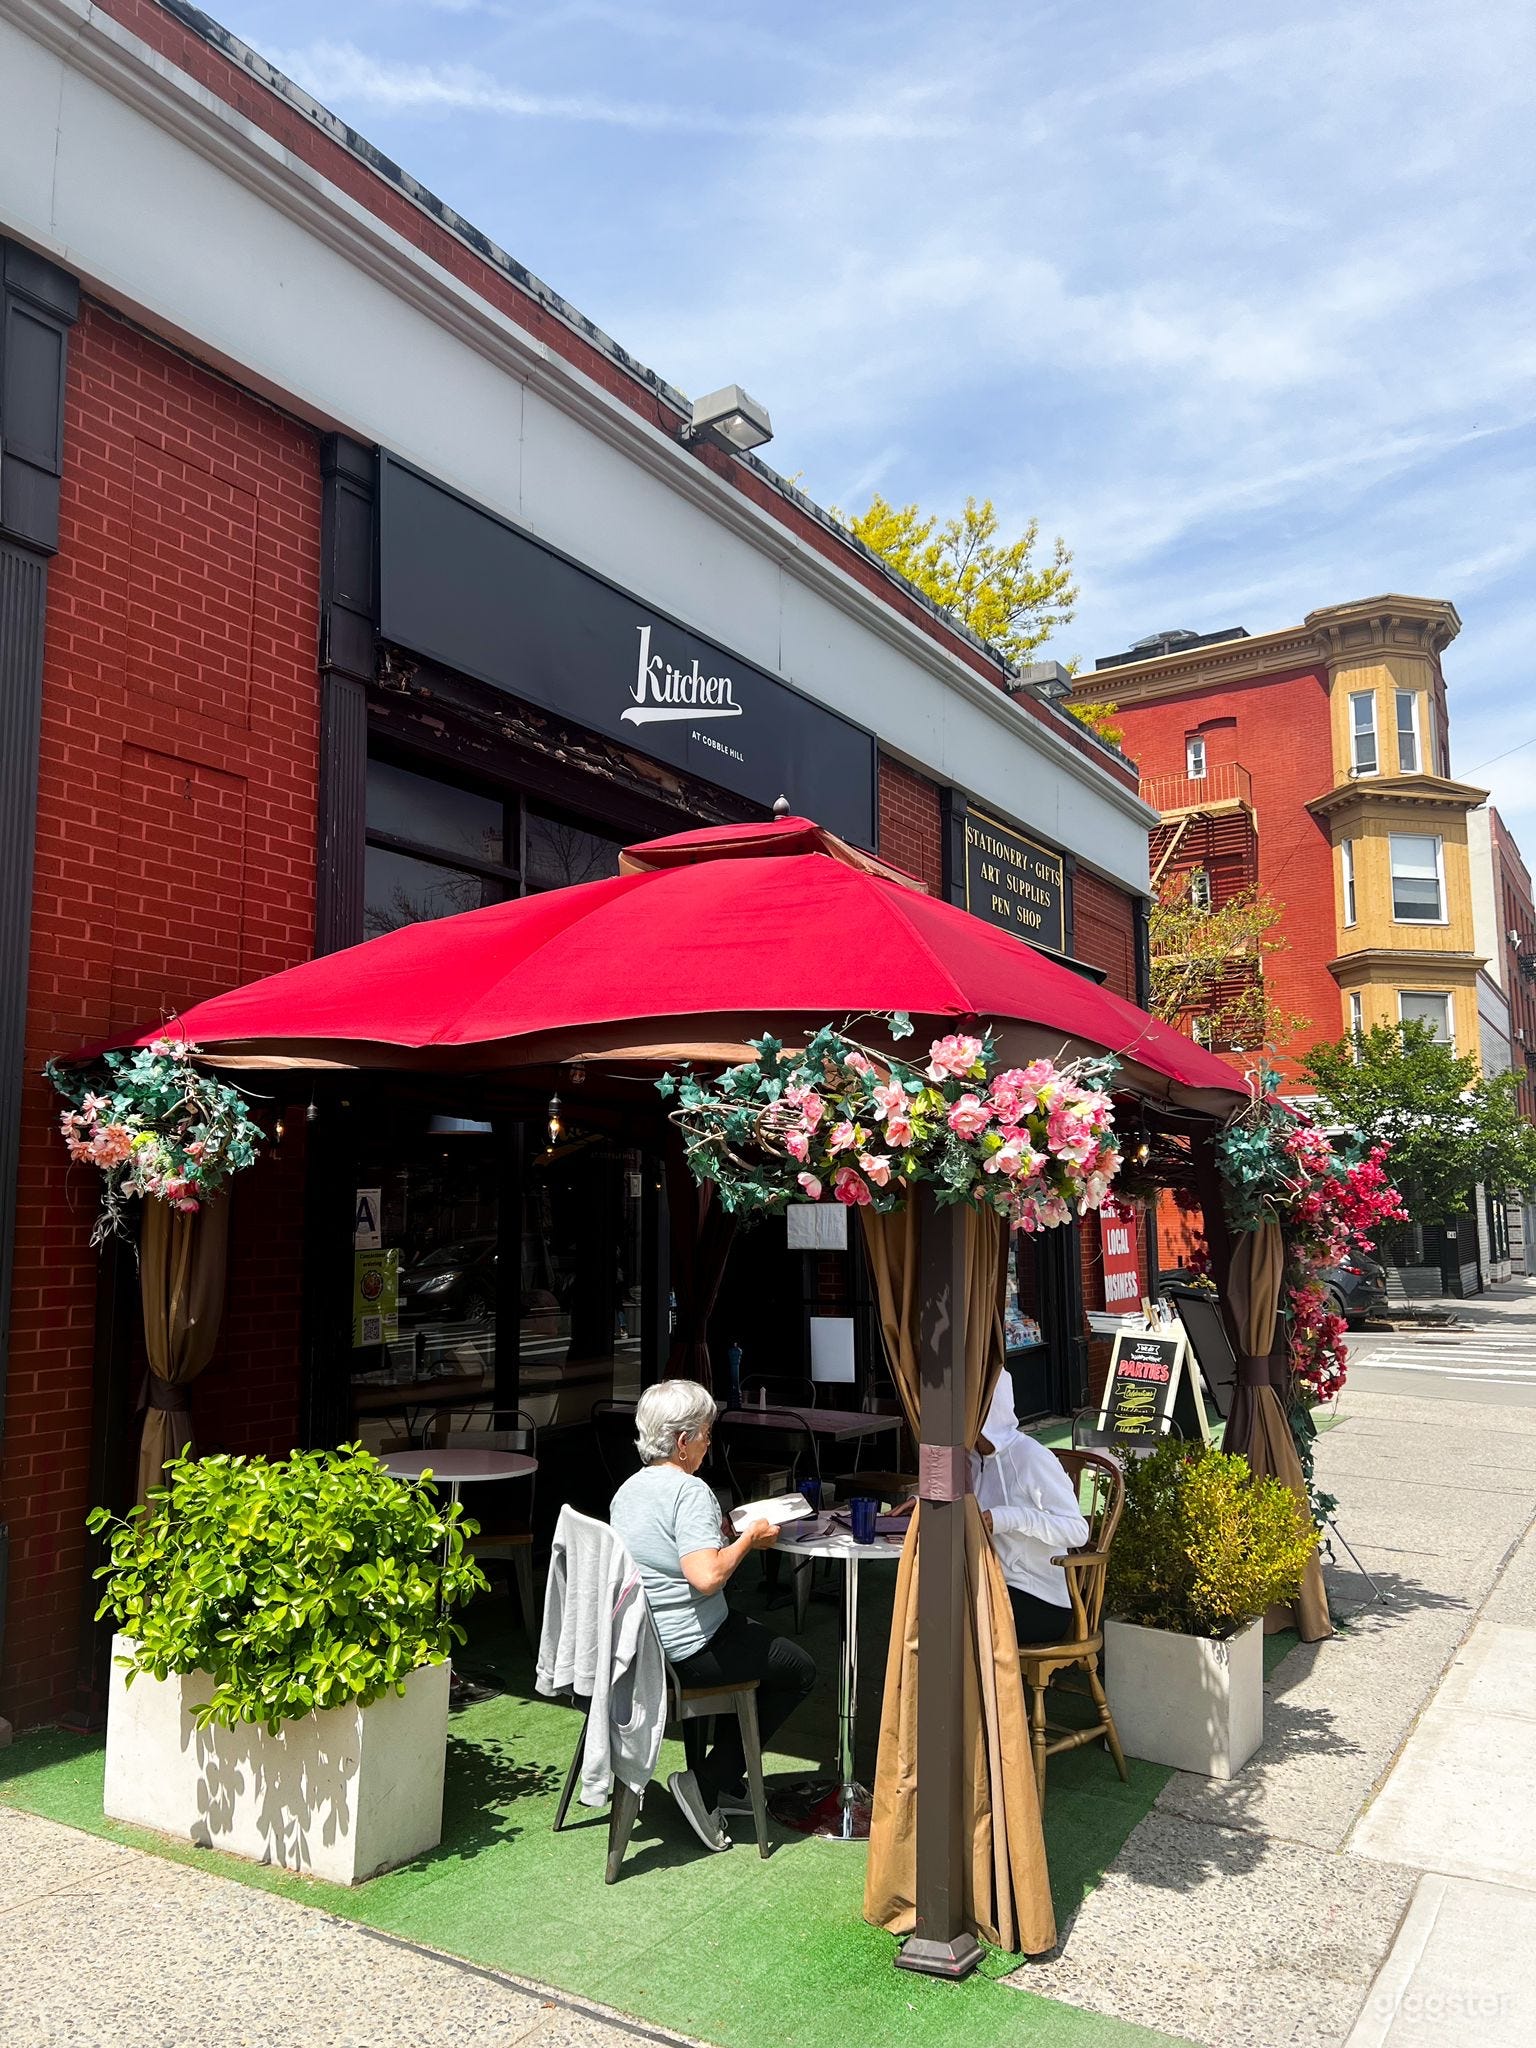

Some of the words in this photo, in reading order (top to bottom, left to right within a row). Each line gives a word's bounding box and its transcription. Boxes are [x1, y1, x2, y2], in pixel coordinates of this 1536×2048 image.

[691, 730, 701, 741] AT
[702, 736, 729, 755] COBBLE
[729, 748, 744, 762] HILL
[967, 826, 1028, 871] STATIONERY
[1035, 861, 1061, 887] GIFTS
[980, 862, 1001, 885] ART
[1006, 873, 1051, 908] SUPPLIES
[991, 894, 1010, 917] PEN
[1016, 905, 1042, 930] SHOP
[354, 1196, 376, 1232] A
[1106, 1228, 1130, 1256] LOCAL
[1104, 1271, 1139, 1303] BUSINESS
[1118, 1360, 1170, 1382] PARTIES
